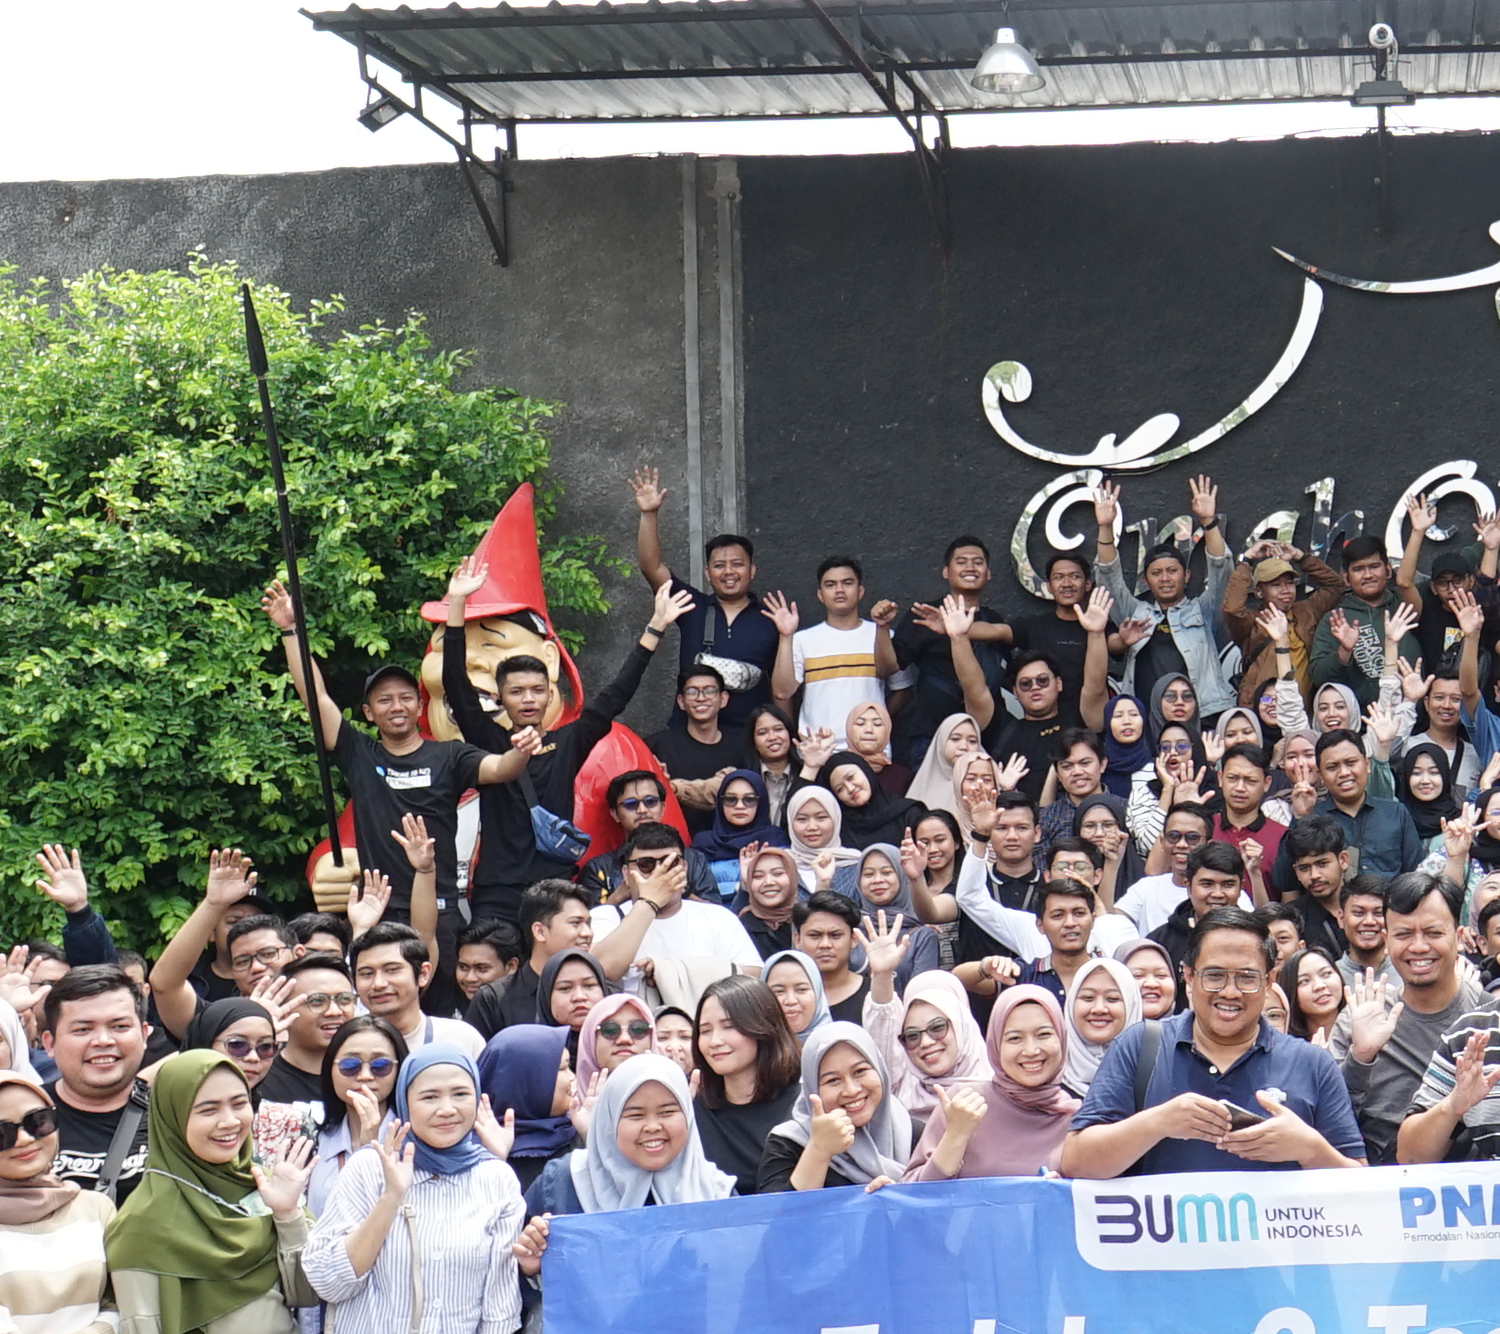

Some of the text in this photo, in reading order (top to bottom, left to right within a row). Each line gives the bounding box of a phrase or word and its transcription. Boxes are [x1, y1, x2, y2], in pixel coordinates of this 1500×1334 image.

[1094, 1192, 1260, 1244] BUMN
[1264, 1206, 1326, 1222] UNTUK
[1266, 1223, 1363, 1240] INDONESIA
[1403, 1232, 1463, 1243] Permodalan
